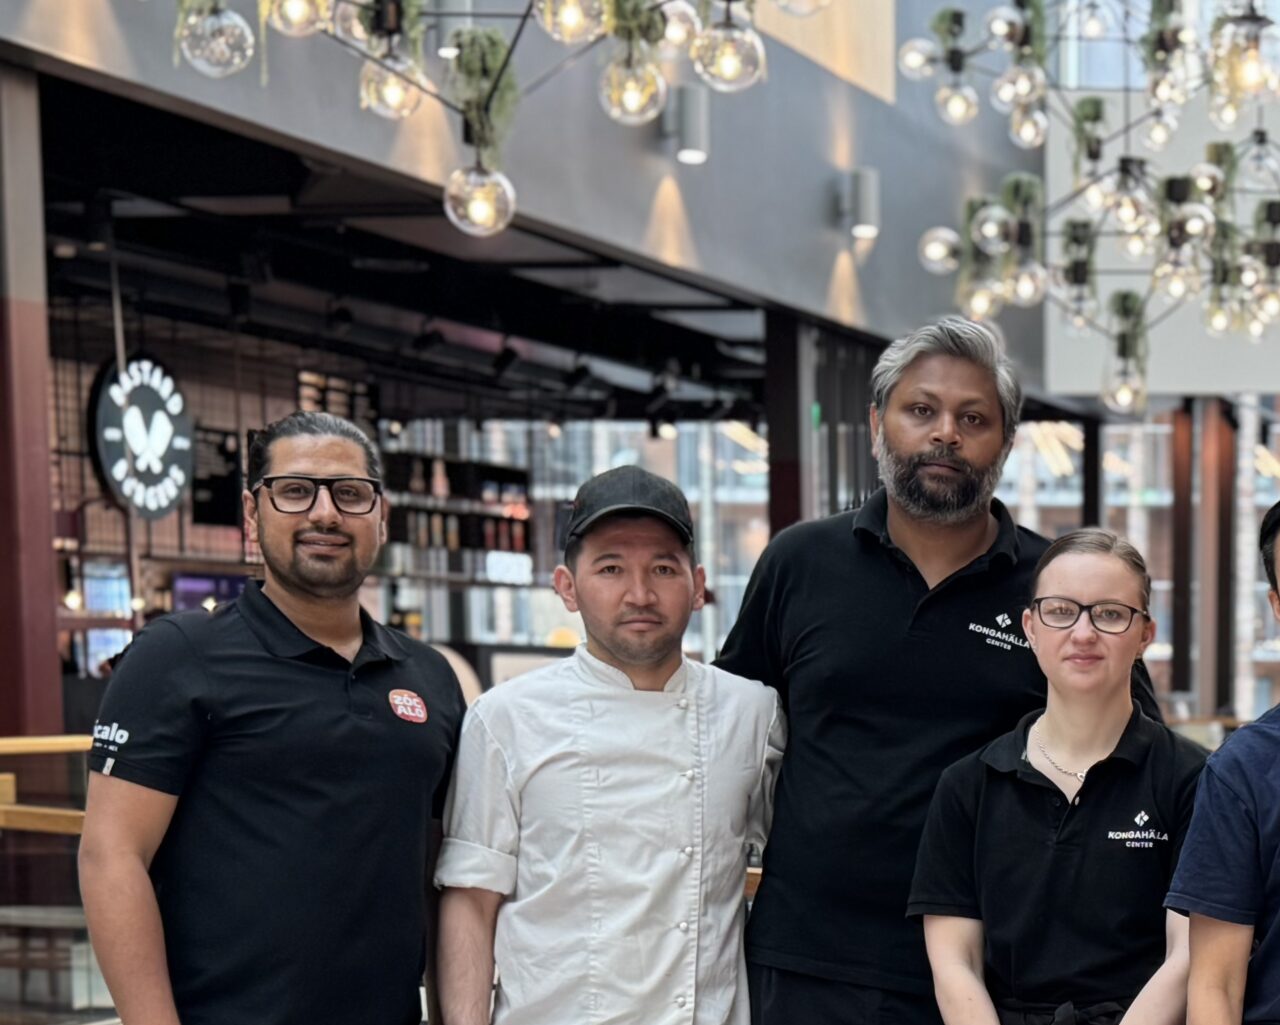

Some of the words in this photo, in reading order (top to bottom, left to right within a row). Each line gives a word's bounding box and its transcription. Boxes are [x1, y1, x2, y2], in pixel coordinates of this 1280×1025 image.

[968, 622, 1031, 649] KONGAHÄLLA
[985, 638, 1012, 650] CENTER
[93, 719, 129, 744] calo
